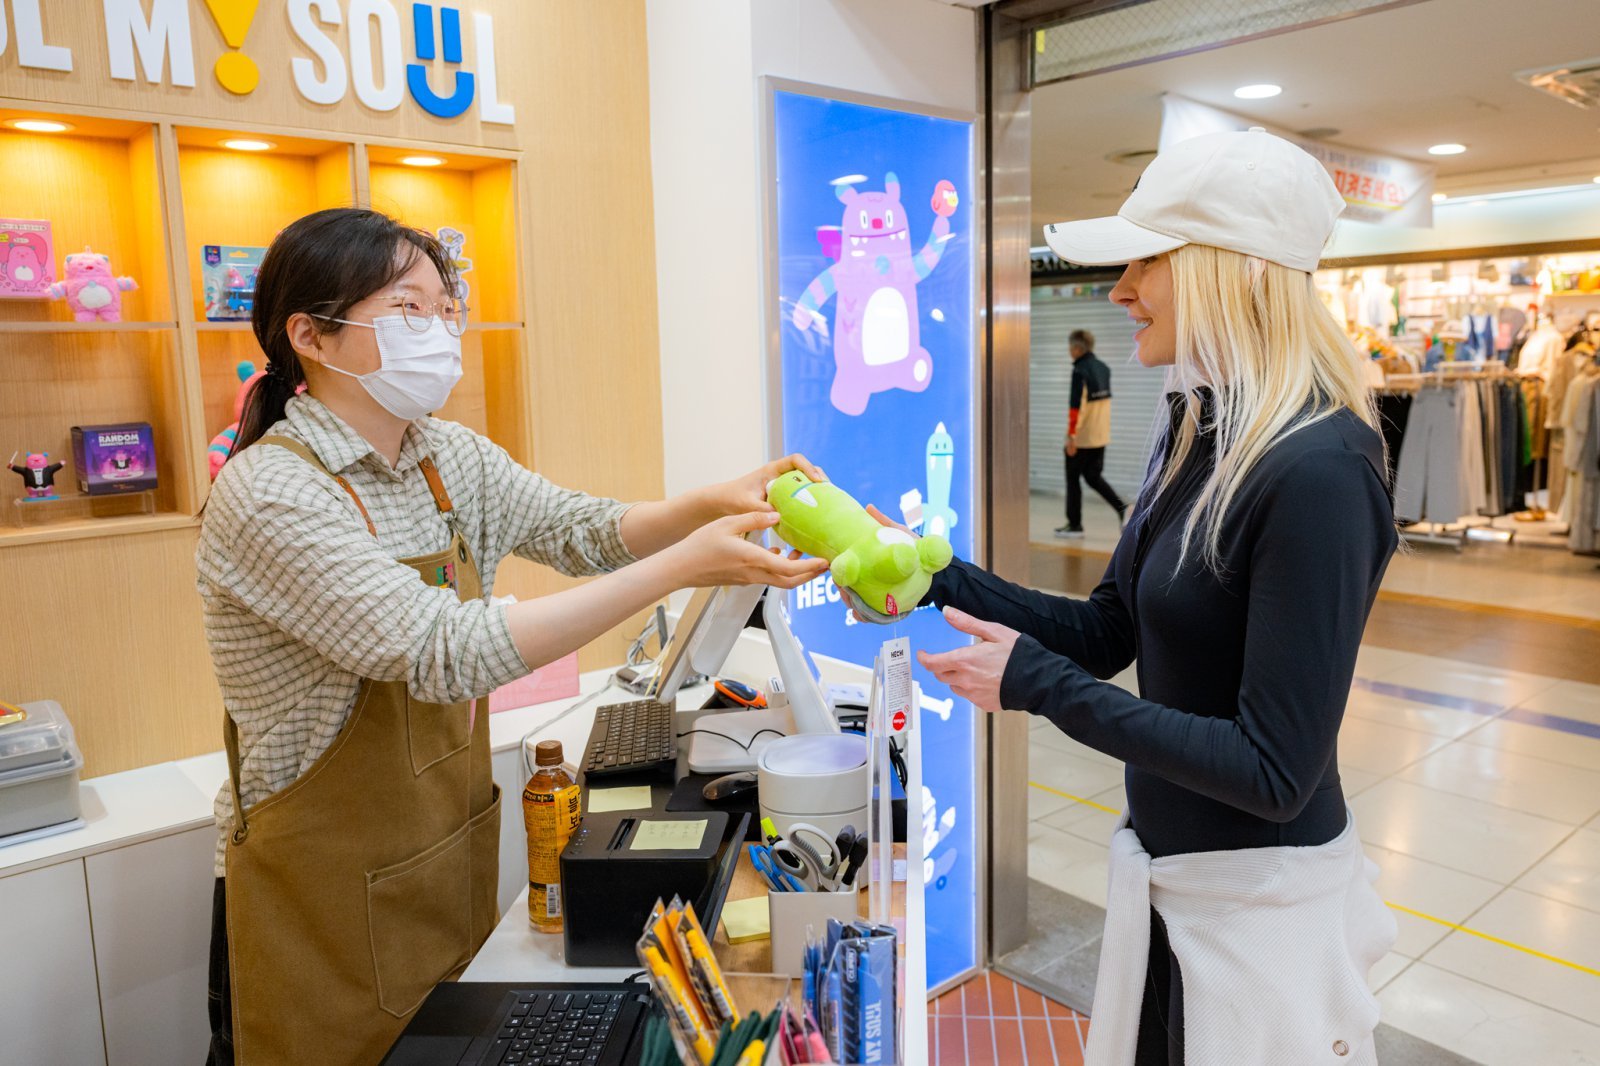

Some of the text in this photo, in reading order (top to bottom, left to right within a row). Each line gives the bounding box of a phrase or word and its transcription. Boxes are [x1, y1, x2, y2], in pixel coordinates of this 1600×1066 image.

[0, 0, 73, 72] L
[287, 0, 515, 125] SOUL
[98, 433, 139, 443] RANDOM
[796, 574, 841, 610] HEC
[865, 1000, 882, 1038] SOUL
